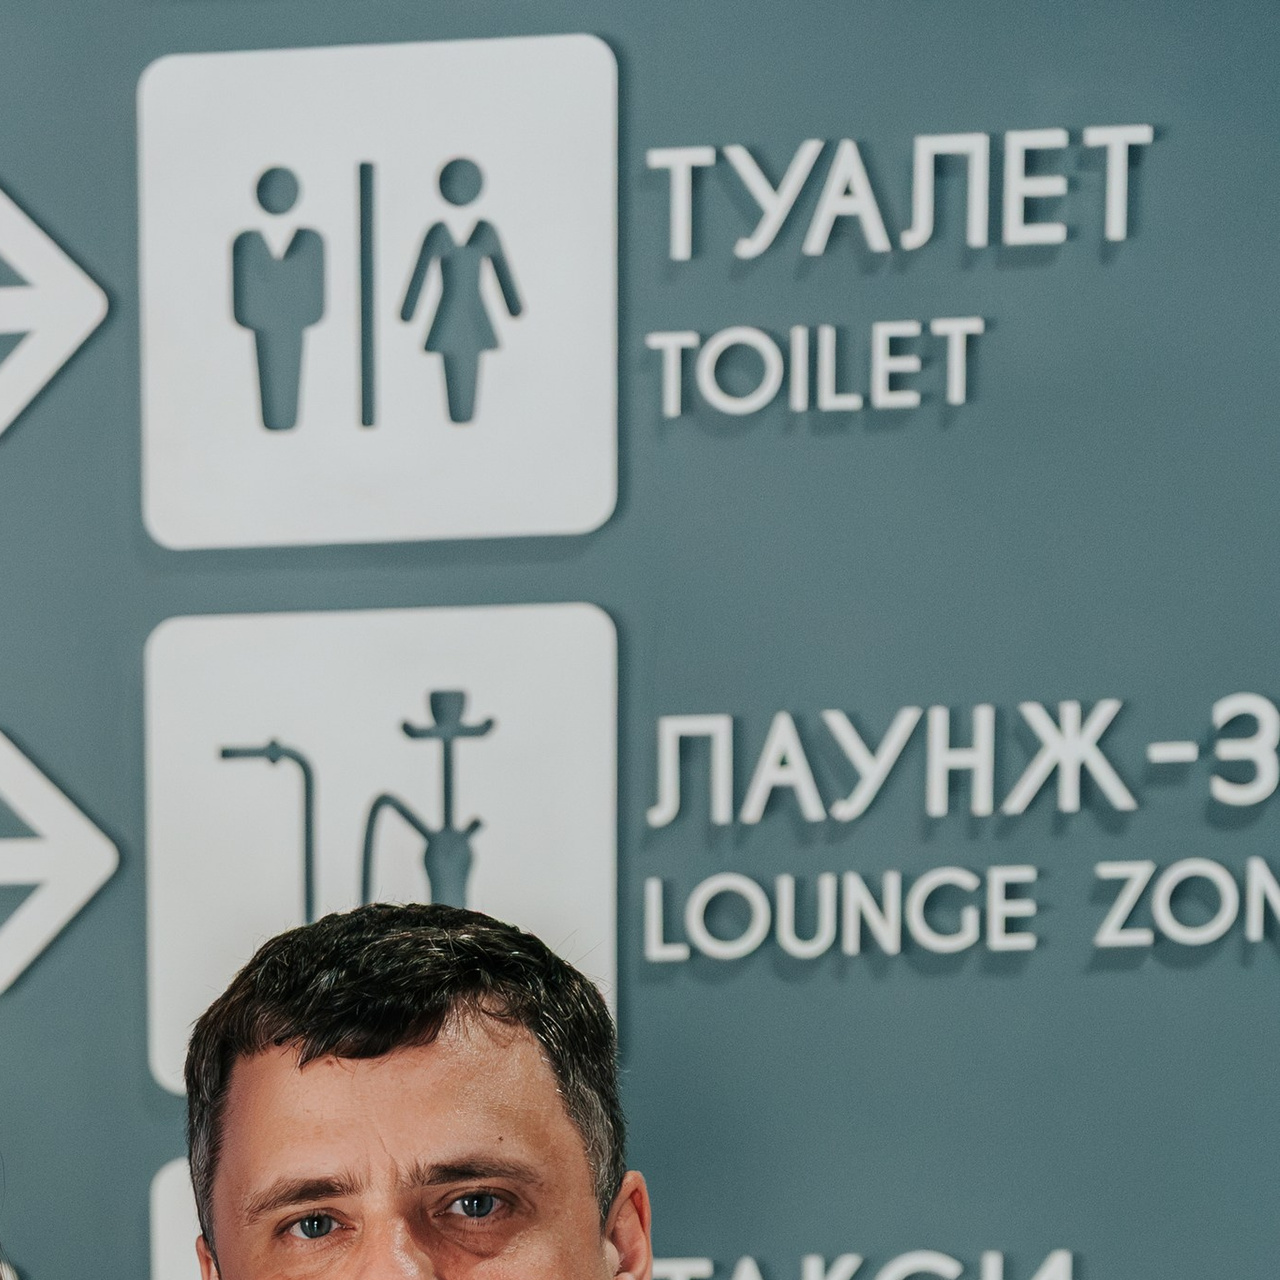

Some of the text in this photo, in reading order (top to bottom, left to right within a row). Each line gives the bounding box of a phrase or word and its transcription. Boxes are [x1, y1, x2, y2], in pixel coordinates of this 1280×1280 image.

[646, 124, 1154, 261] ТУАЛЕТ
[646, 316, 985, 417] TOILET
[646, 692, 1280, 828] ЛАУНЖ-З
[644, 865, 1038, 962] LOUNGE
